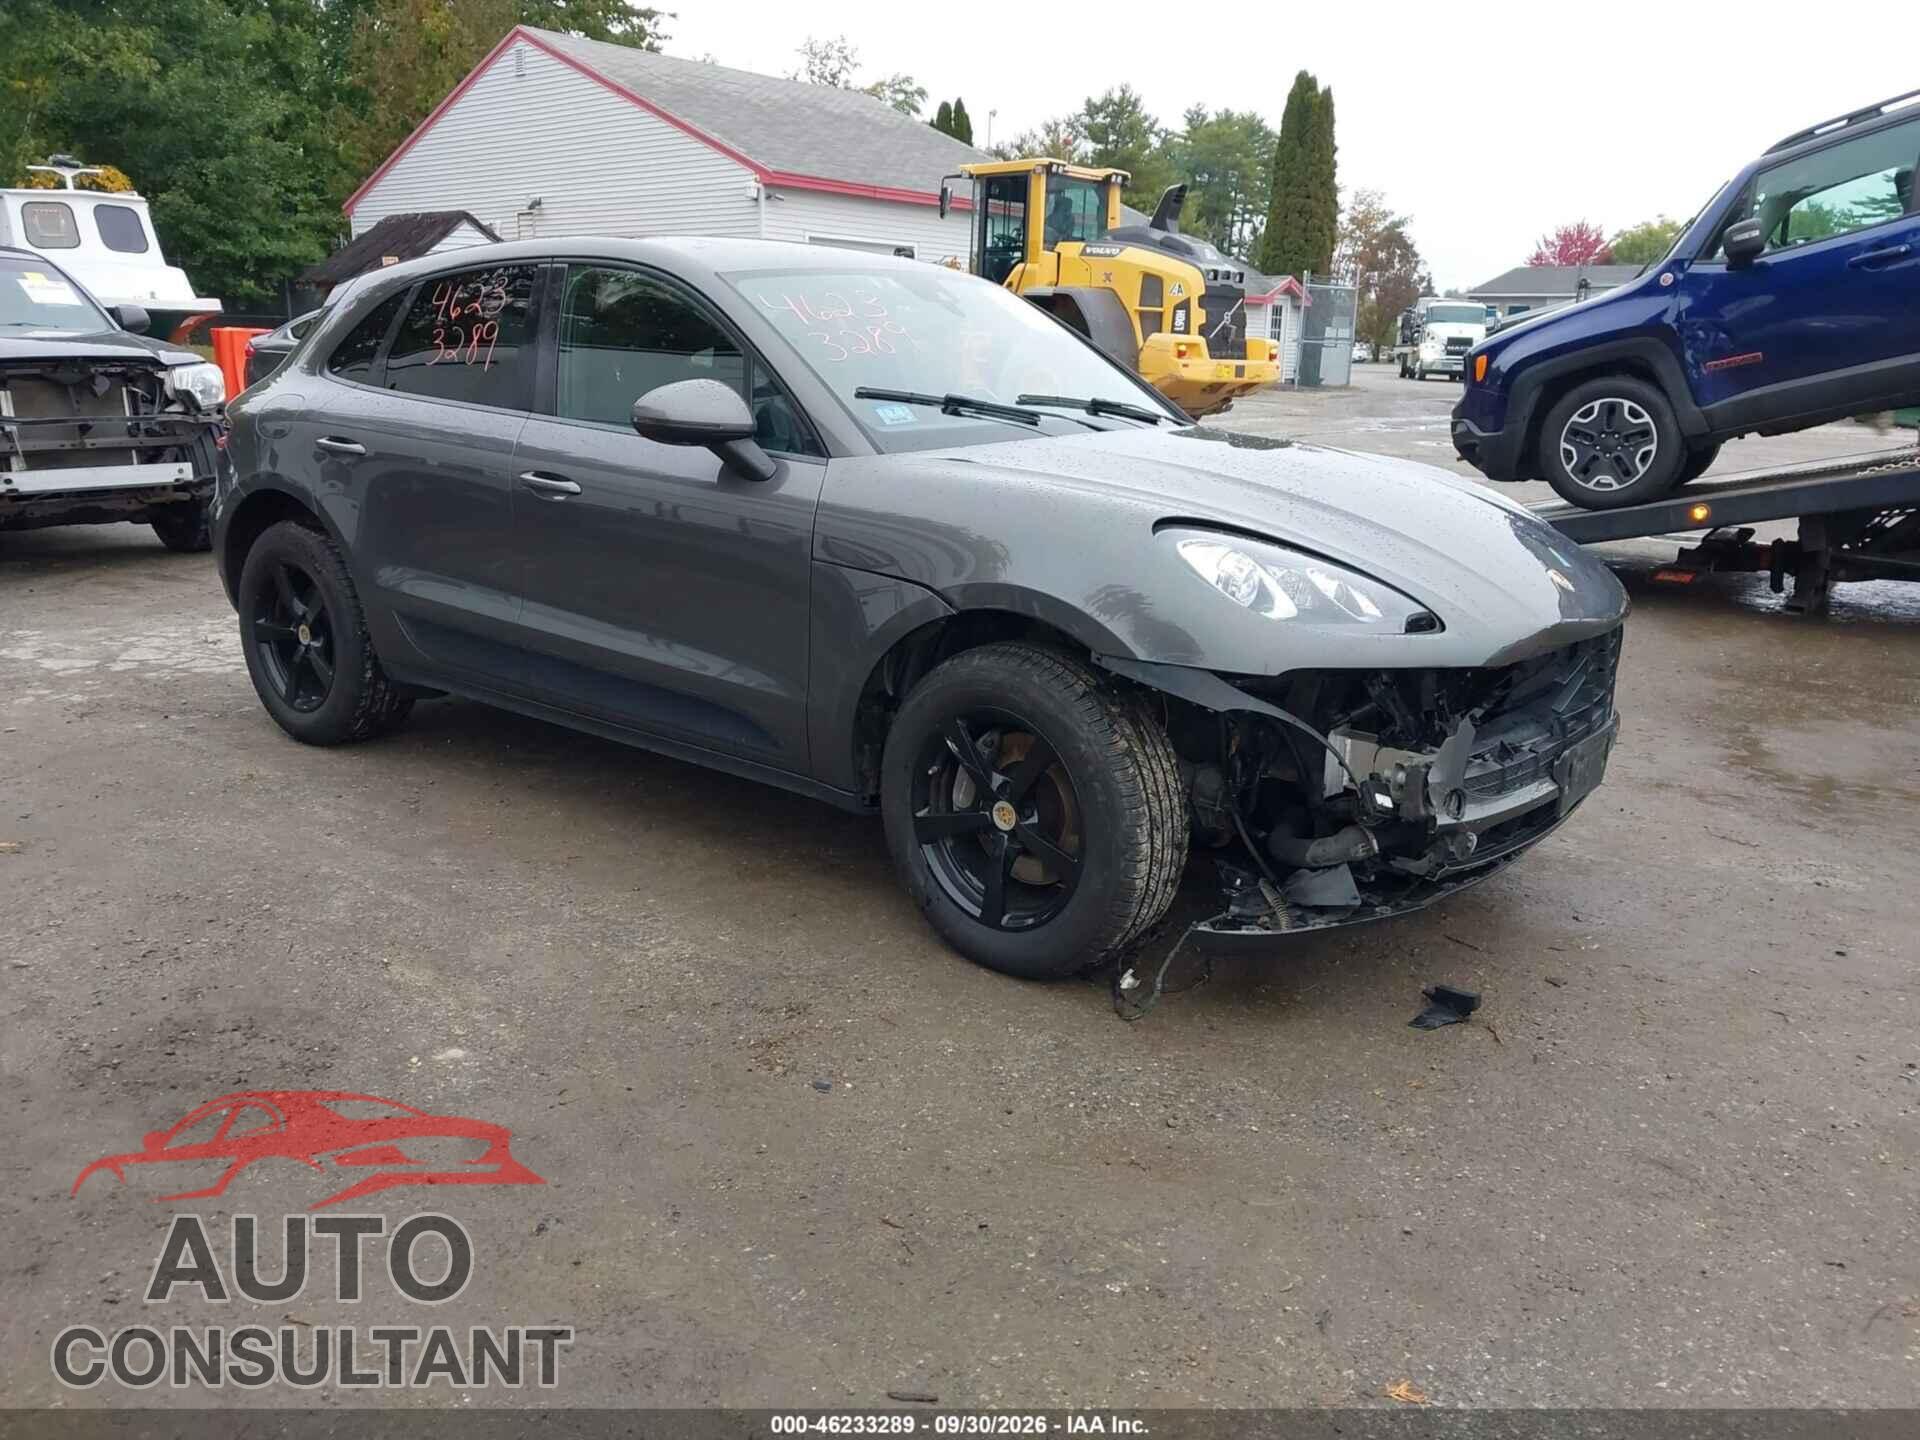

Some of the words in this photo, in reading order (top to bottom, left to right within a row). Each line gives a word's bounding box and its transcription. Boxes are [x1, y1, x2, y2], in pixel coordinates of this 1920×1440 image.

[432, 276, 507, 321] 4623
[758, 294, 888, 325] 4623
[424, 320, 500, 373] 3289
[808, 320, 922, 361] 3289
